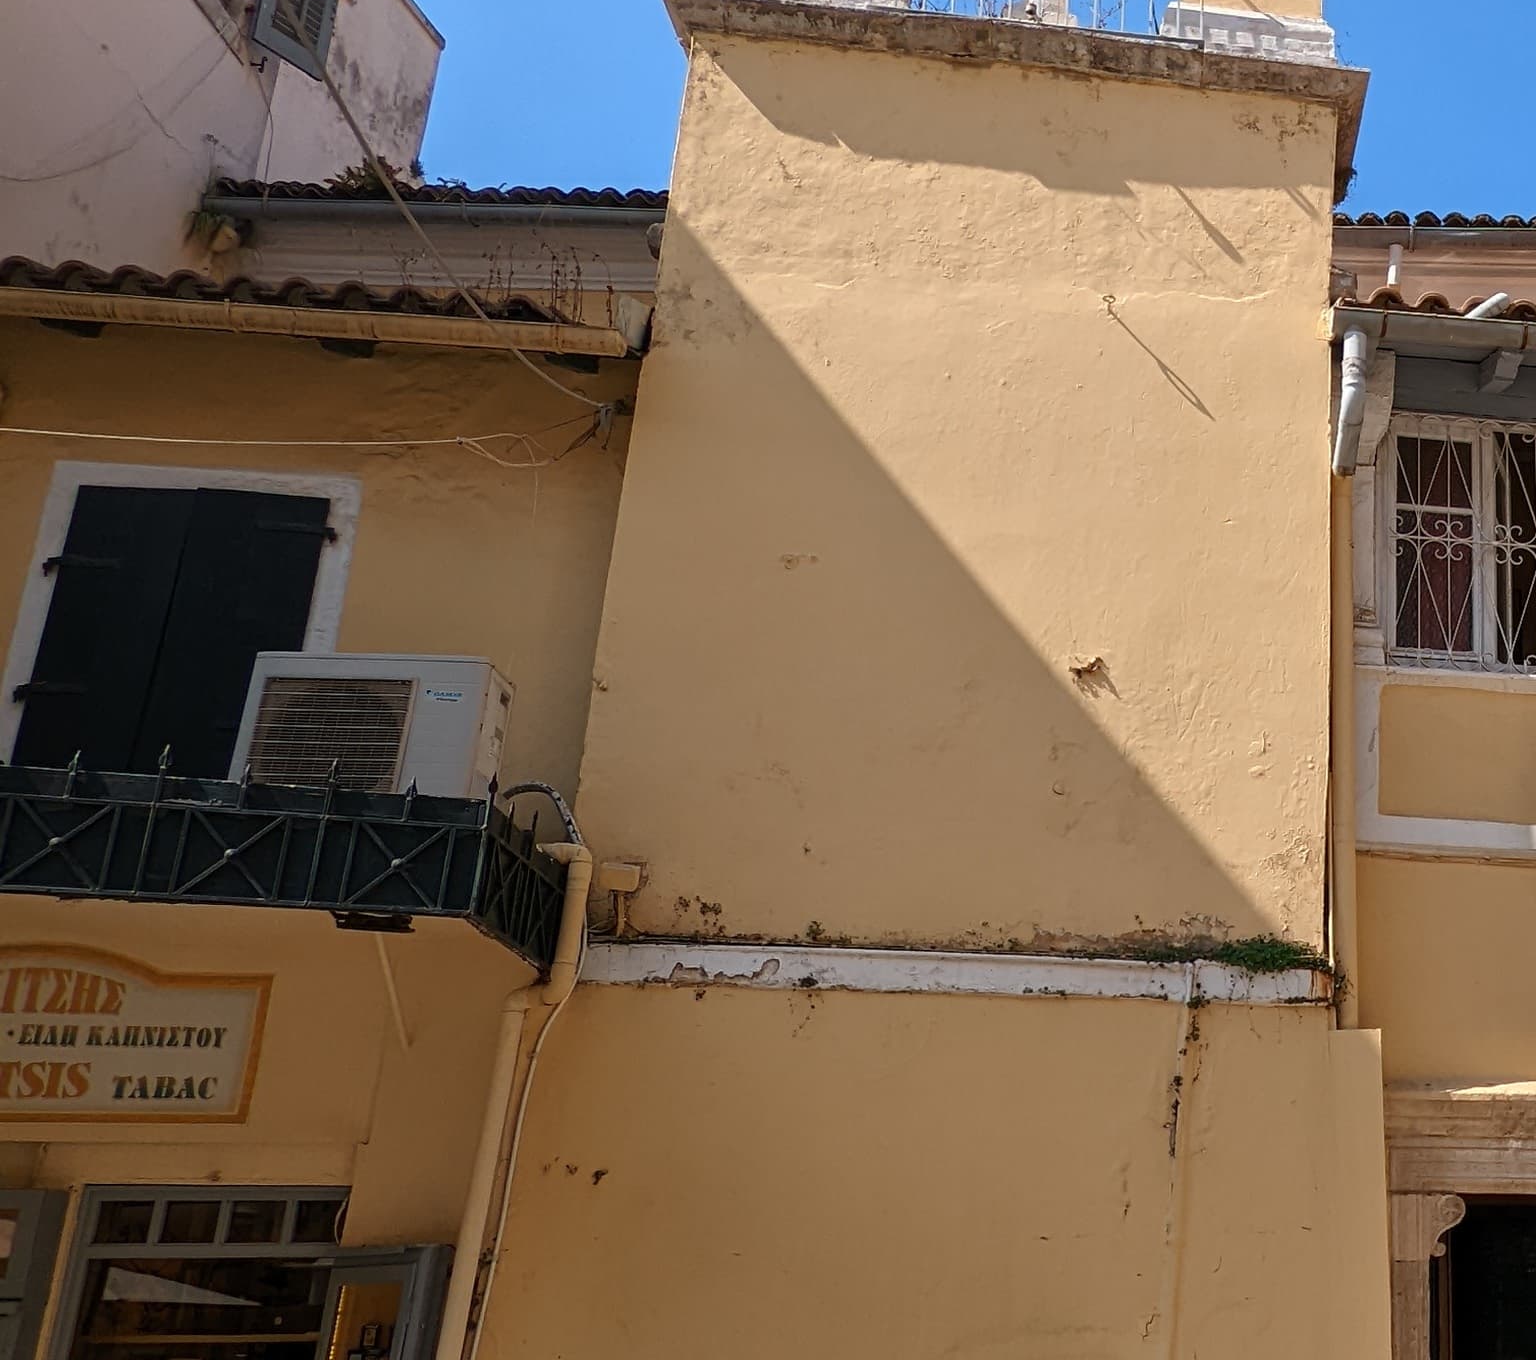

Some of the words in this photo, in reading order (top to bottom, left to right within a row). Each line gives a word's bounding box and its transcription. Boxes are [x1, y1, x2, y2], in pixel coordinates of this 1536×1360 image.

[0, 967, 127, 1015] ΙΤΣΗΣ
[85, 1025, 229, 1049] ΚΑΠΝΙΣΤΟΥ
[112, 1075, 219, 1100] TABAC
